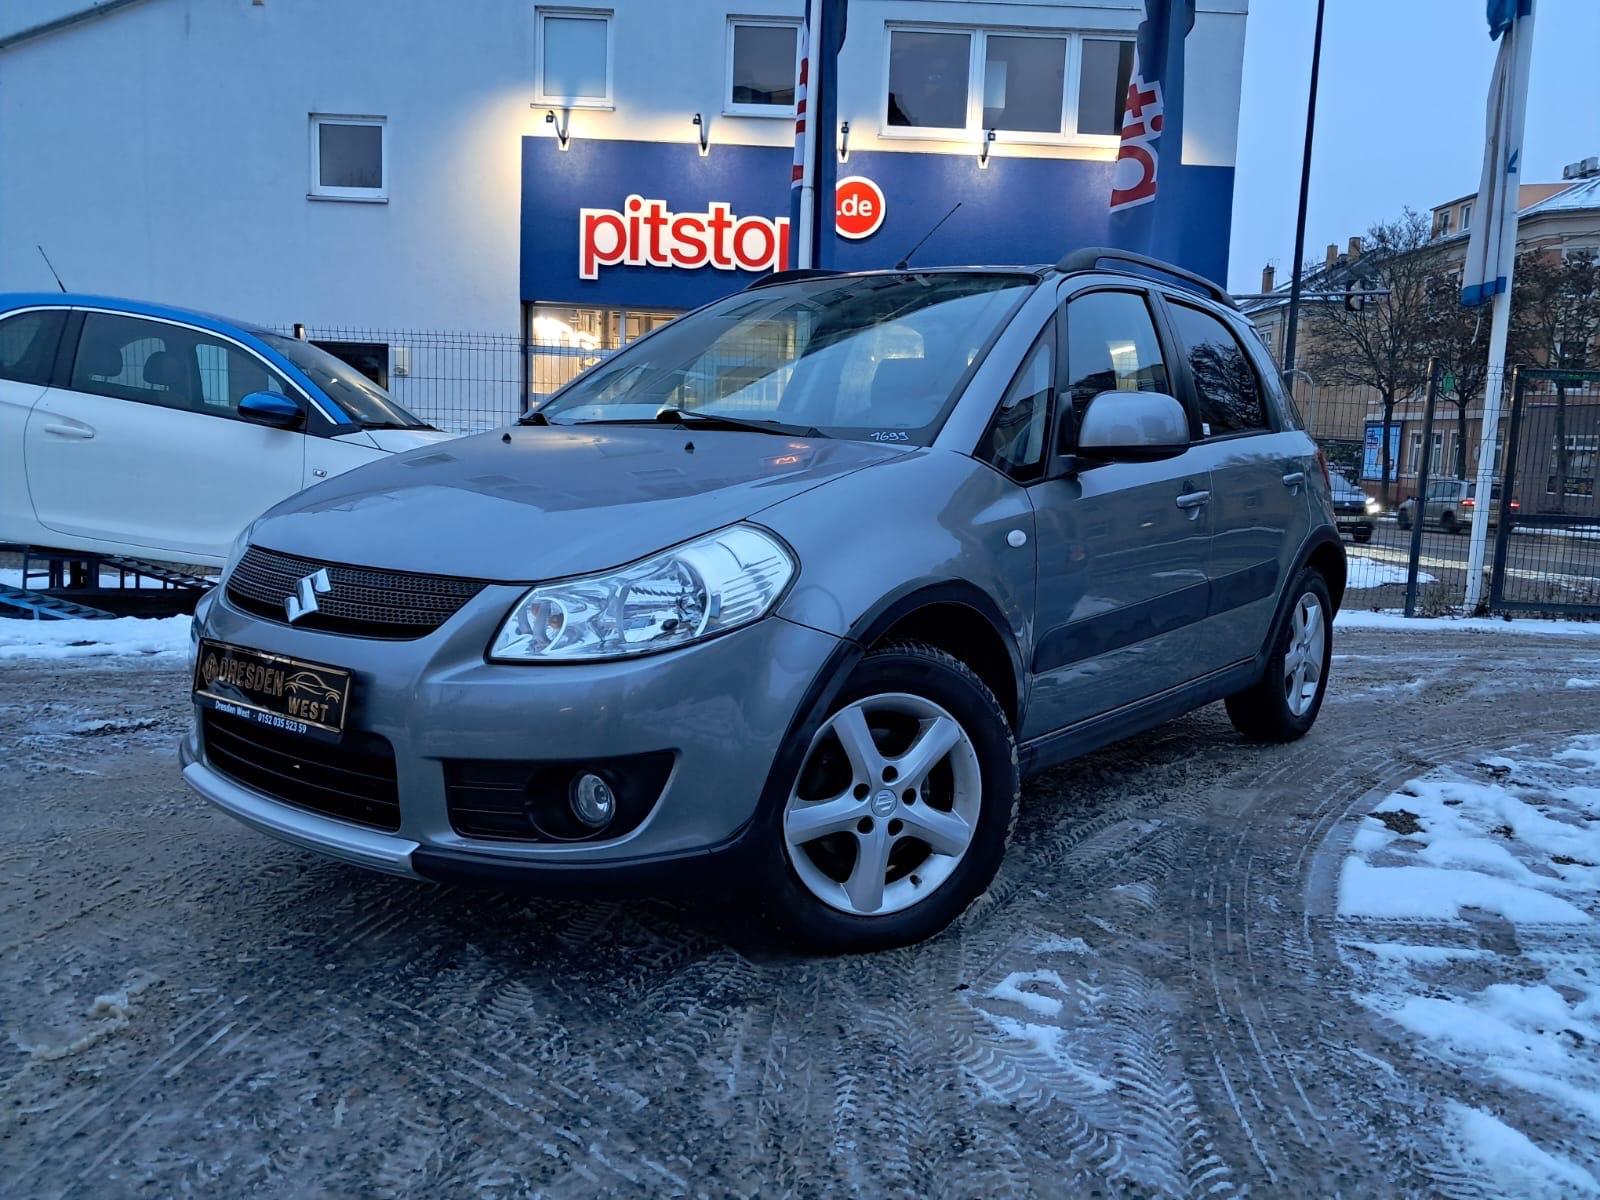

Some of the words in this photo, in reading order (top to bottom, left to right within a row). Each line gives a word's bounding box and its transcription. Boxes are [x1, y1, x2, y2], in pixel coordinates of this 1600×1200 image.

[218, 656, 285, 697] DRESDEN
[215, 700, 236, 714] Dresden
[236, 706, 251, 718] West
[257, 712, 273, 725] 0152
[273, 716, 285, 728] 035
[285, 720, 298, 732] 523
[298, 723, 307, 734] 59
[288, 697, 329, 722] WEST
